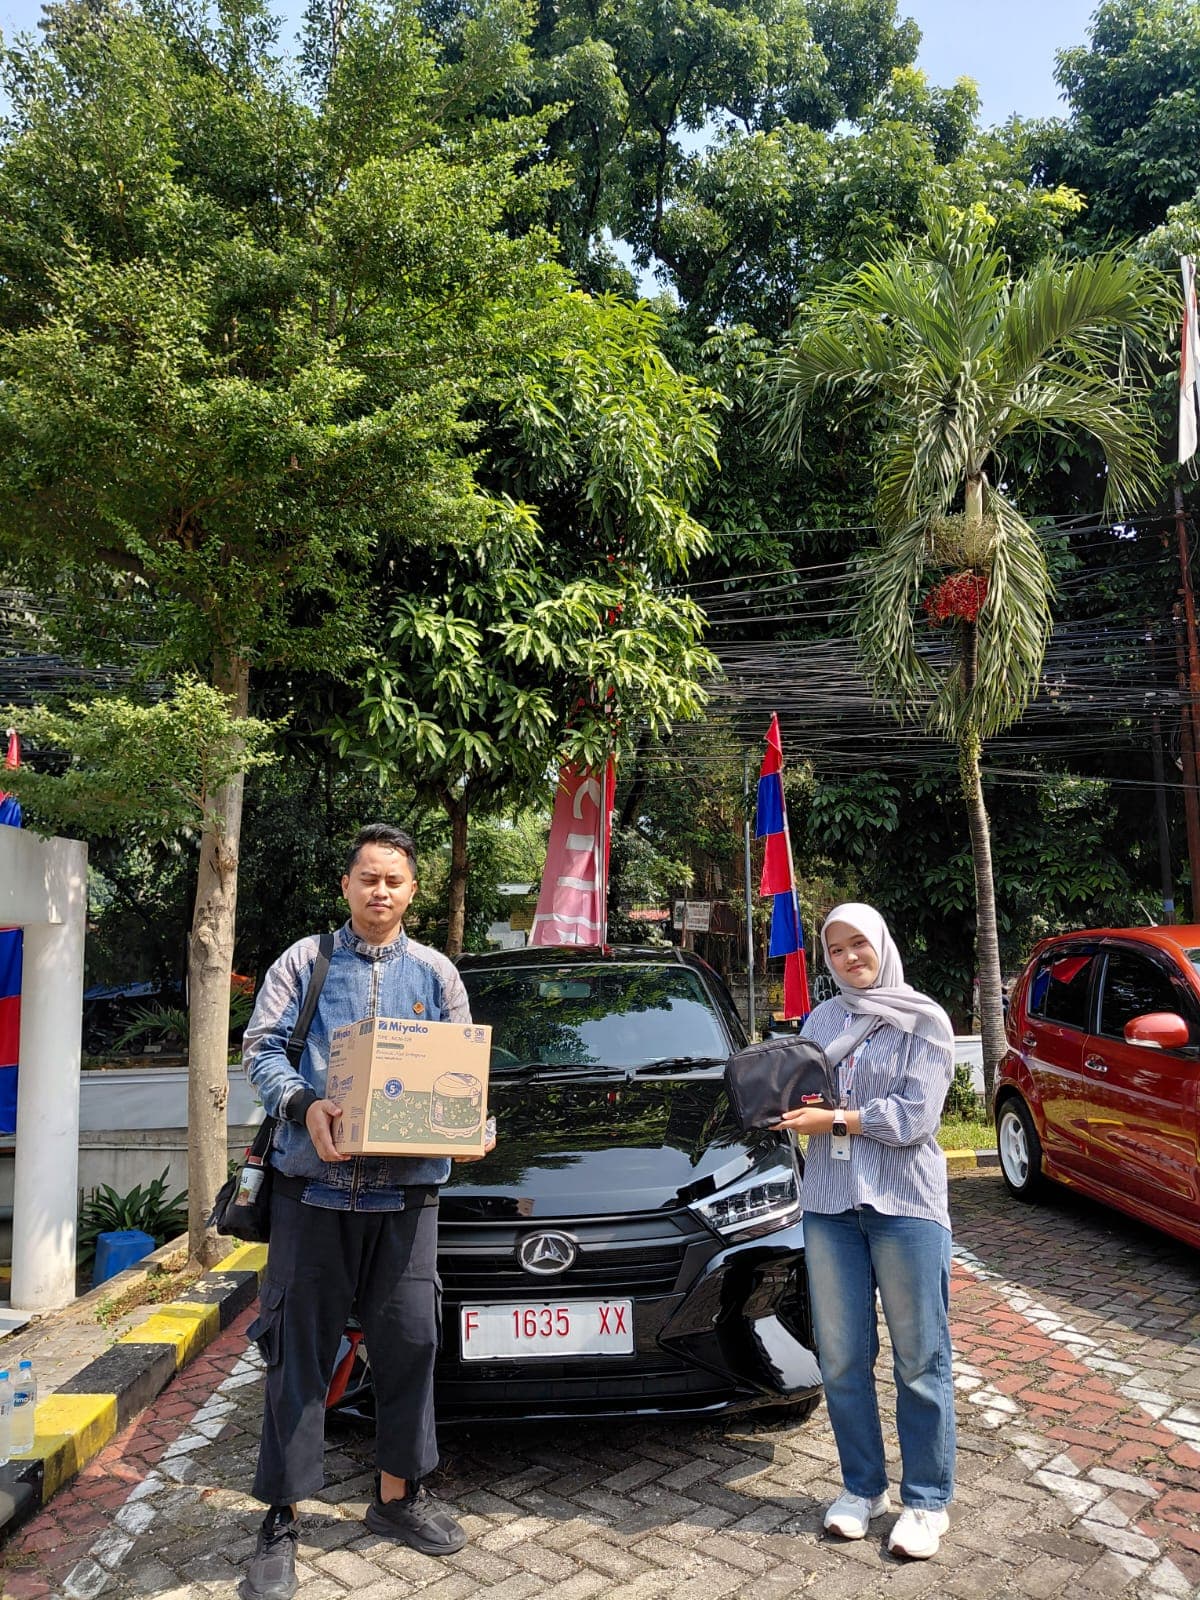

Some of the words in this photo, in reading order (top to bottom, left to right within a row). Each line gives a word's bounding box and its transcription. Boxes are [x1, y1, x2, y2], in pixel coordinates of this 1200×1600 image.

[389, 1021, 429, 1034] Miyako
[465, 1312, 479, 1341] F
[513, 1308, 570, 1338] 1635
[599, 1306, 627, 1334] XX
